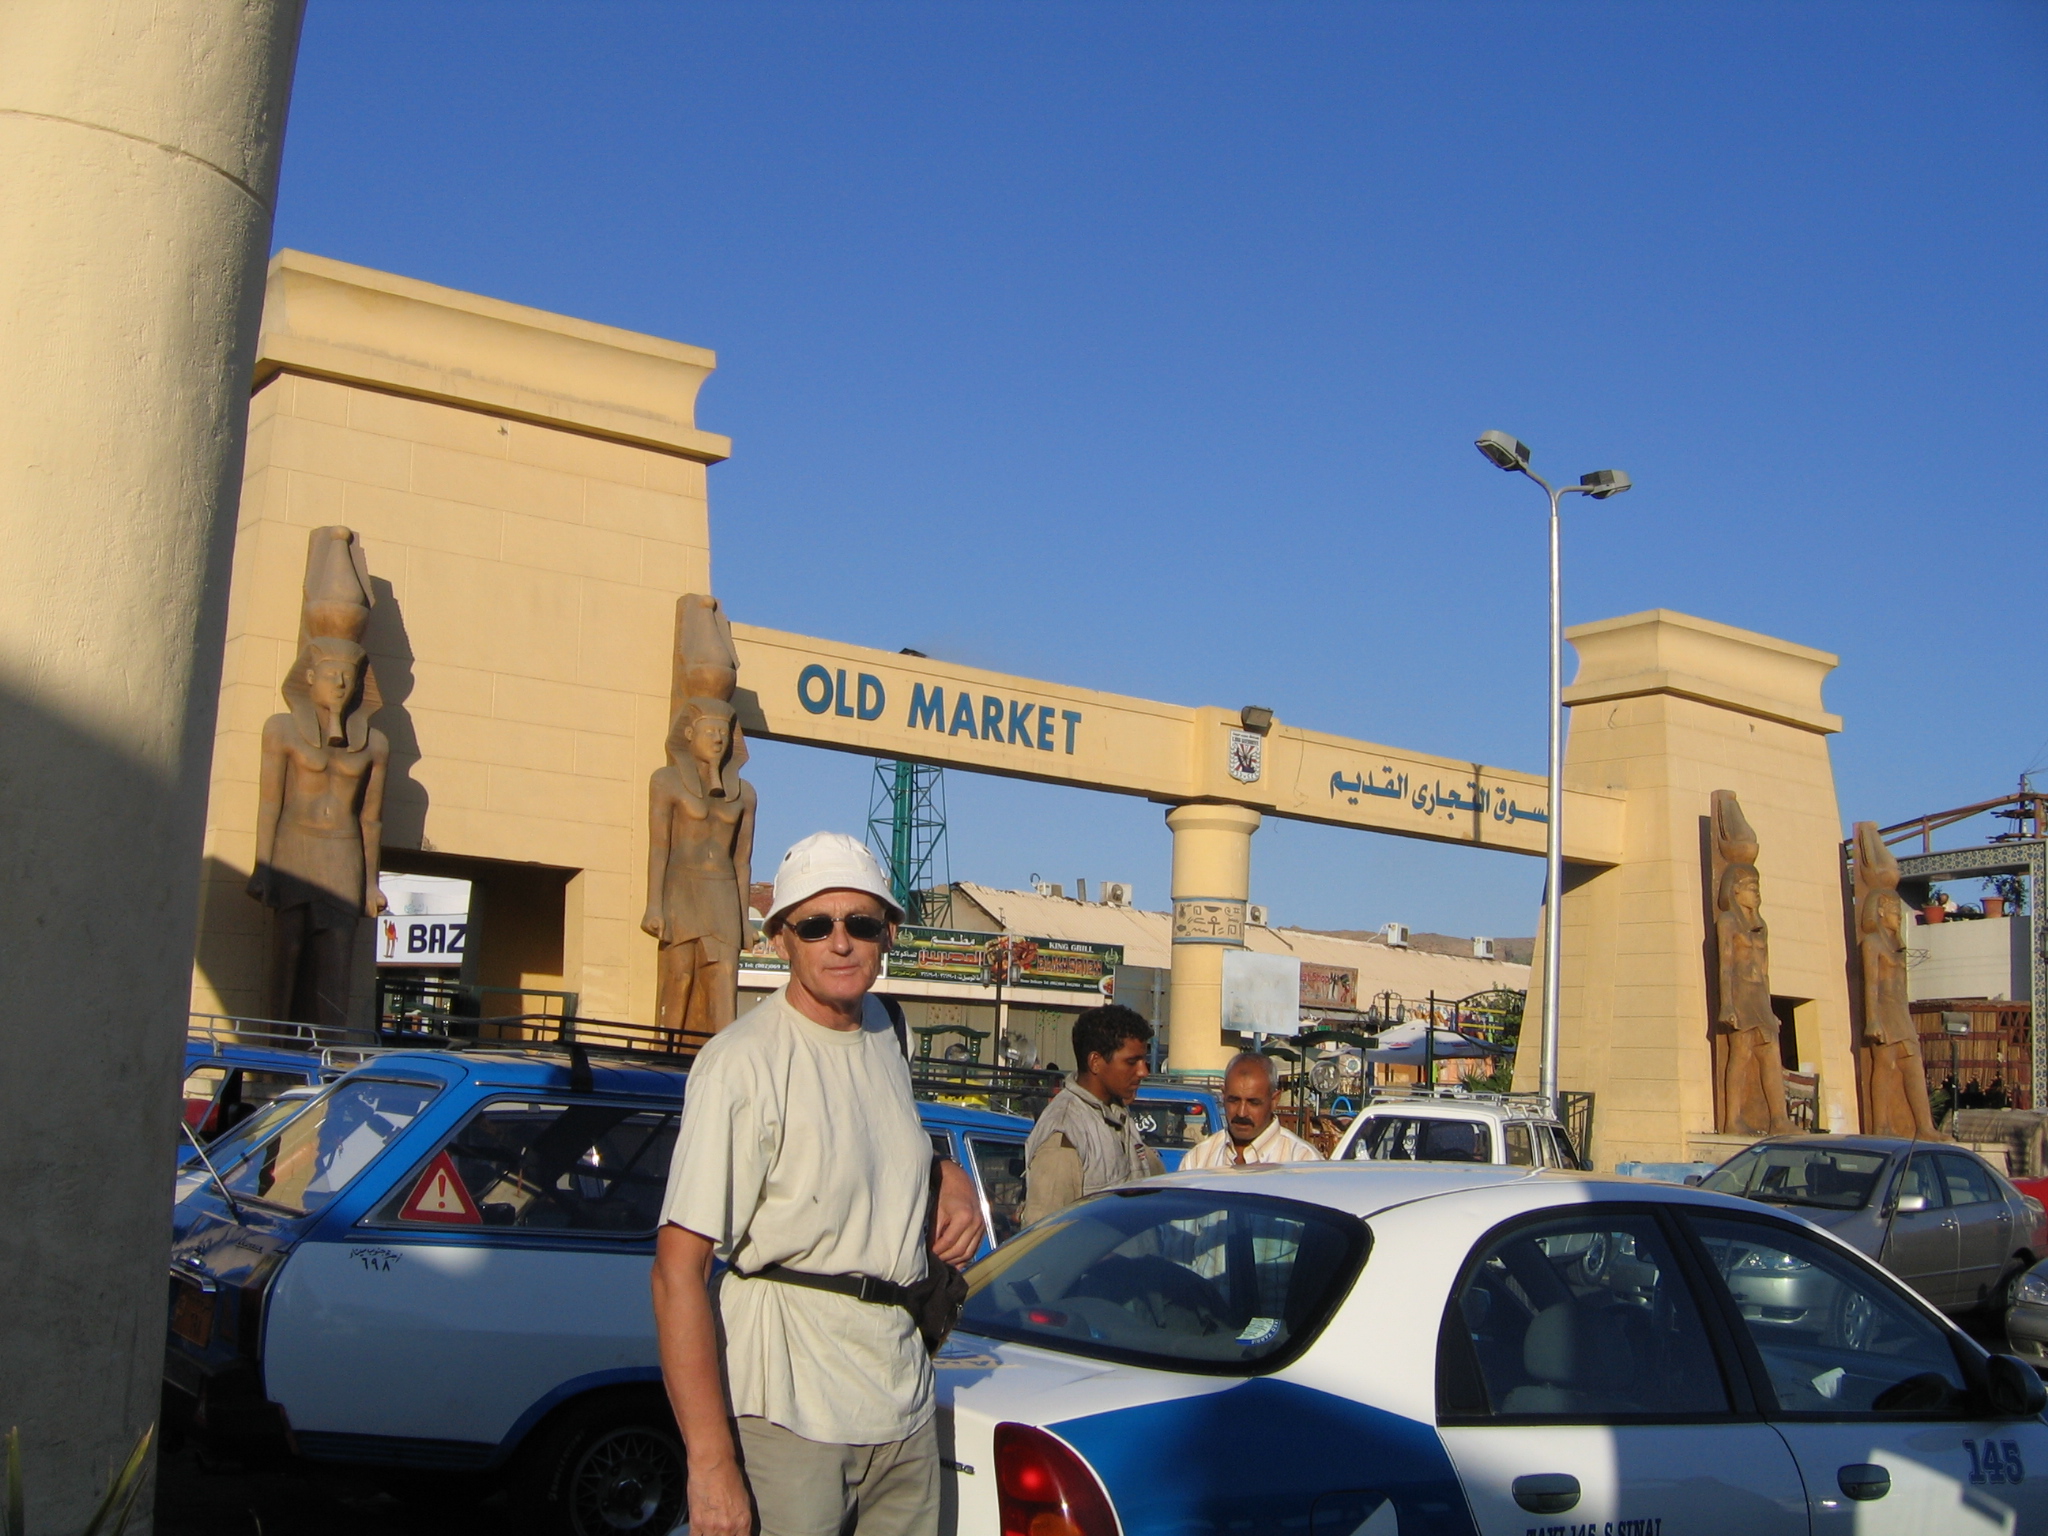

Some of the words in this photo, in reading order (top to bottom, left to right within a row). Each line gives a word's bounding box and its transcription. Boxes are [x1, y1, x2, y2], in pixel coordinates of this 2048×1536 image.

[797, 663, 885, 721] OLD
[907, 682, 1082, 755] MARKET
[1329, 765, 1409, 805] القديم
[931, 935, 975, 947] مطعم
[1049, 942, 1068, 950] KING
[1071, 944, 1094, 952] GRILL
[361, 1257, 390, 1271] ٦٩٨
[1962, 1439, 2025, 1485] 145
